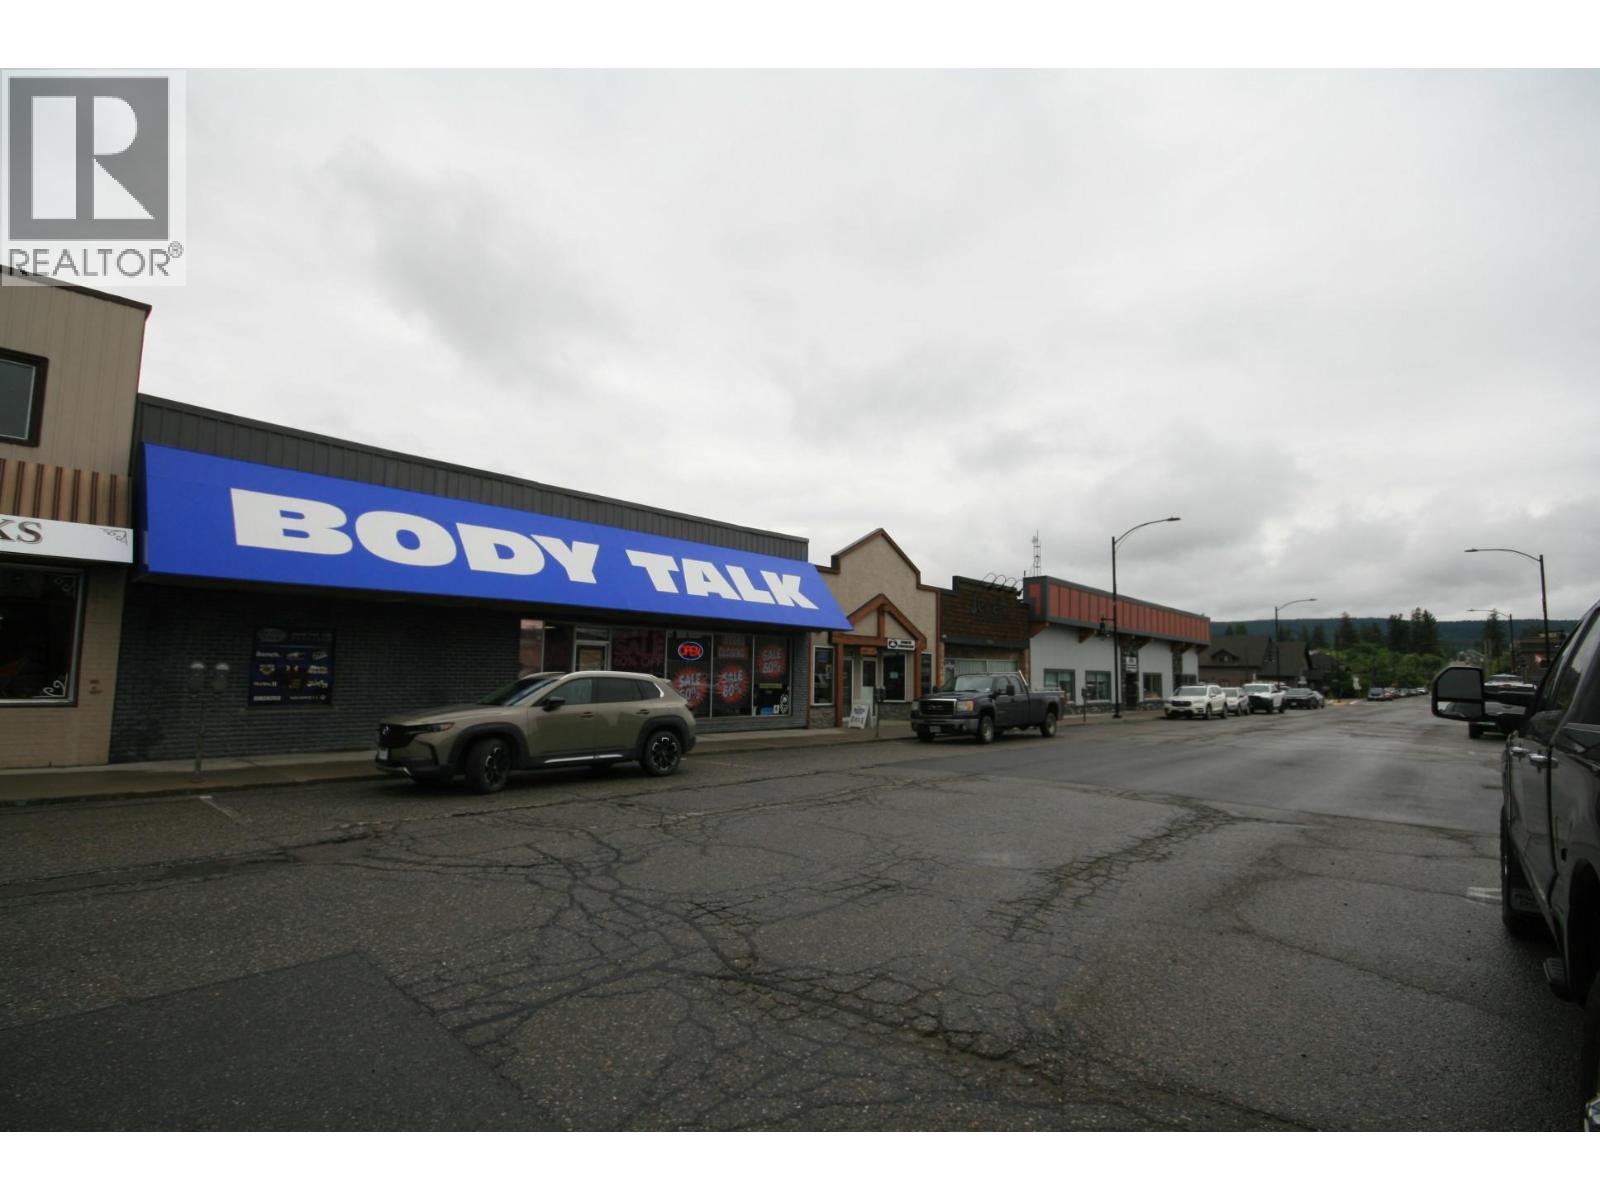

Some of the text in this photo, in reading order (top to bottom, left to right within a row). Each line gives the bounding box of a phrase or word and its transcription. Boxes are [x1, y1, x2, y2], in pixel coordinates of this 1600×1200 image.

[230, 488, 819, 610] BODY TALK
[680, 644, 701, 657] OPEN
[762, 648, 783, 661] SALE
[679, 672, 702, 686] SALE
[720, 670, 743, 683] SALE
